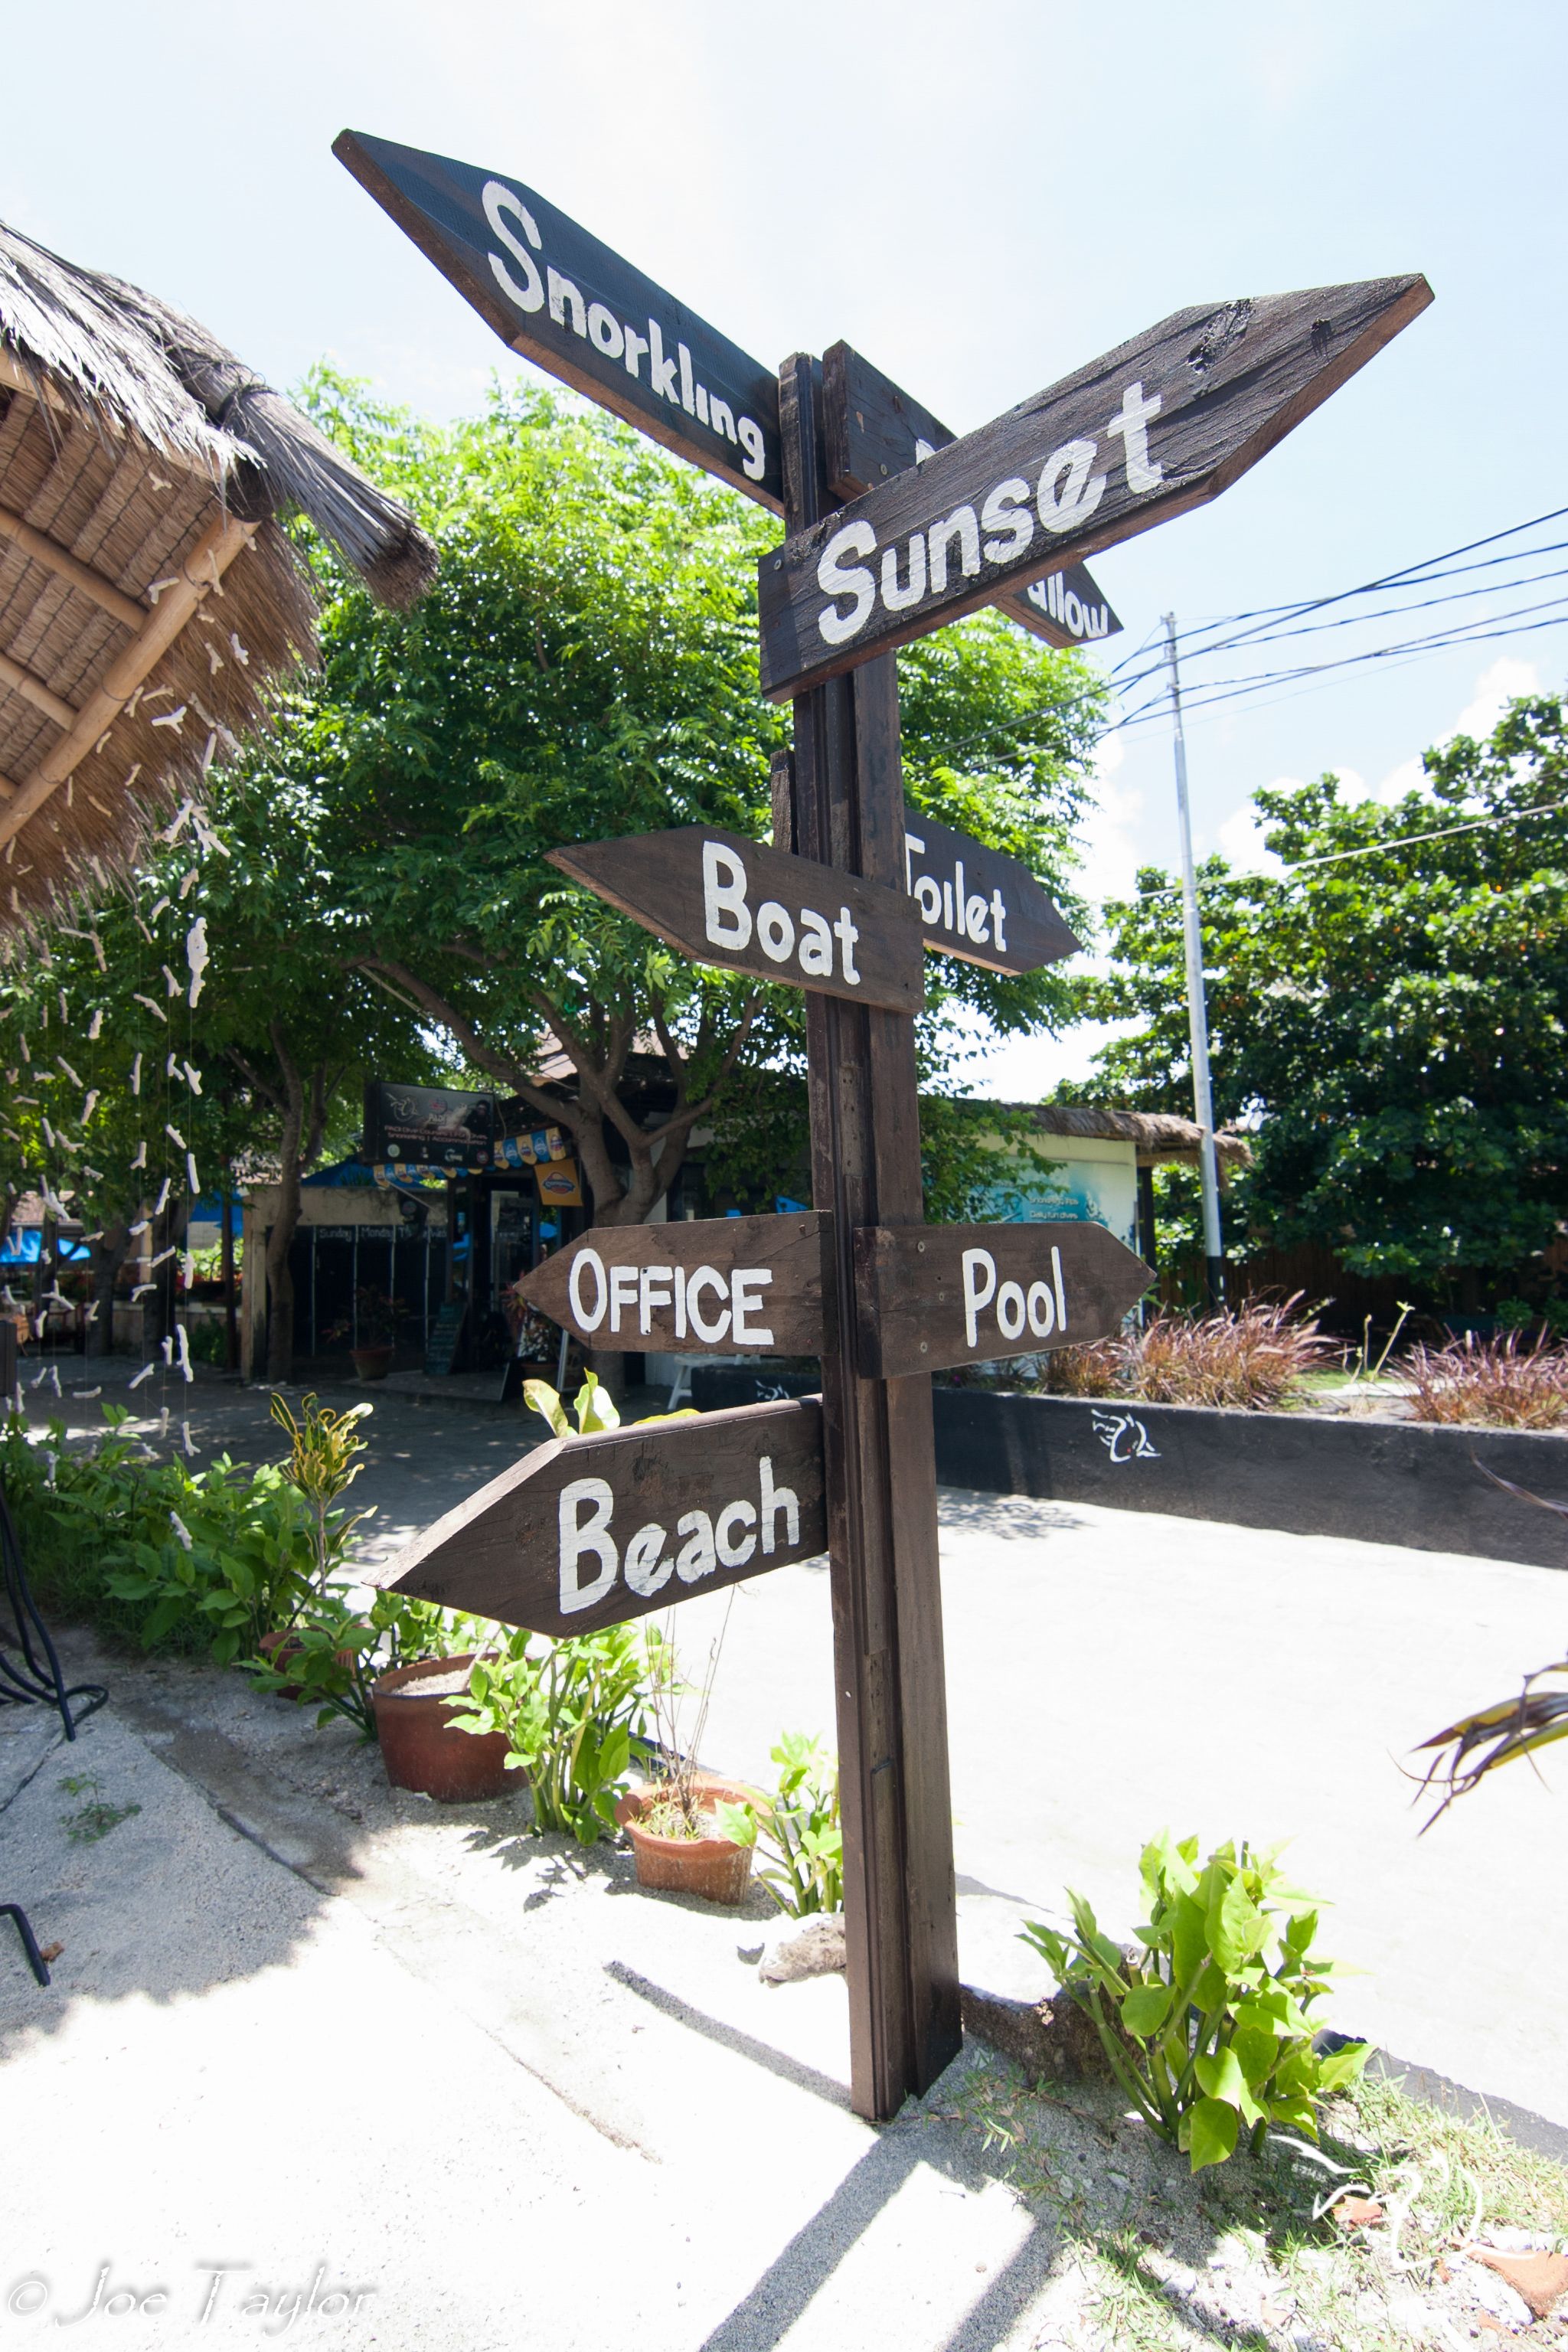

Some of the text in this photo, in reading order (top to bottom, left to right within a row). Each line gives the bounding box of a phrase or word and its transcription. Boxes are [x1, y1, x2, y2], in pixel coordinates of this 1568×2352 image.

[482, 180, 766, 482] Snorkling
[817, 381, 1165, 645] Sunset
[702, 841, 861, 986] Boat
[905, 833, 1007, 952] Toilet
[318, 1228, 353, 1242] Sunday
[361, 1227, 393, 1242] Monday
[1029, 1210, 1047, 1219] Daily
[569, 1248, 774, 1346] OFFICE
[962, 1246, 1067, 1348] Pool
[558, 1456, 800, 1615] Beach
